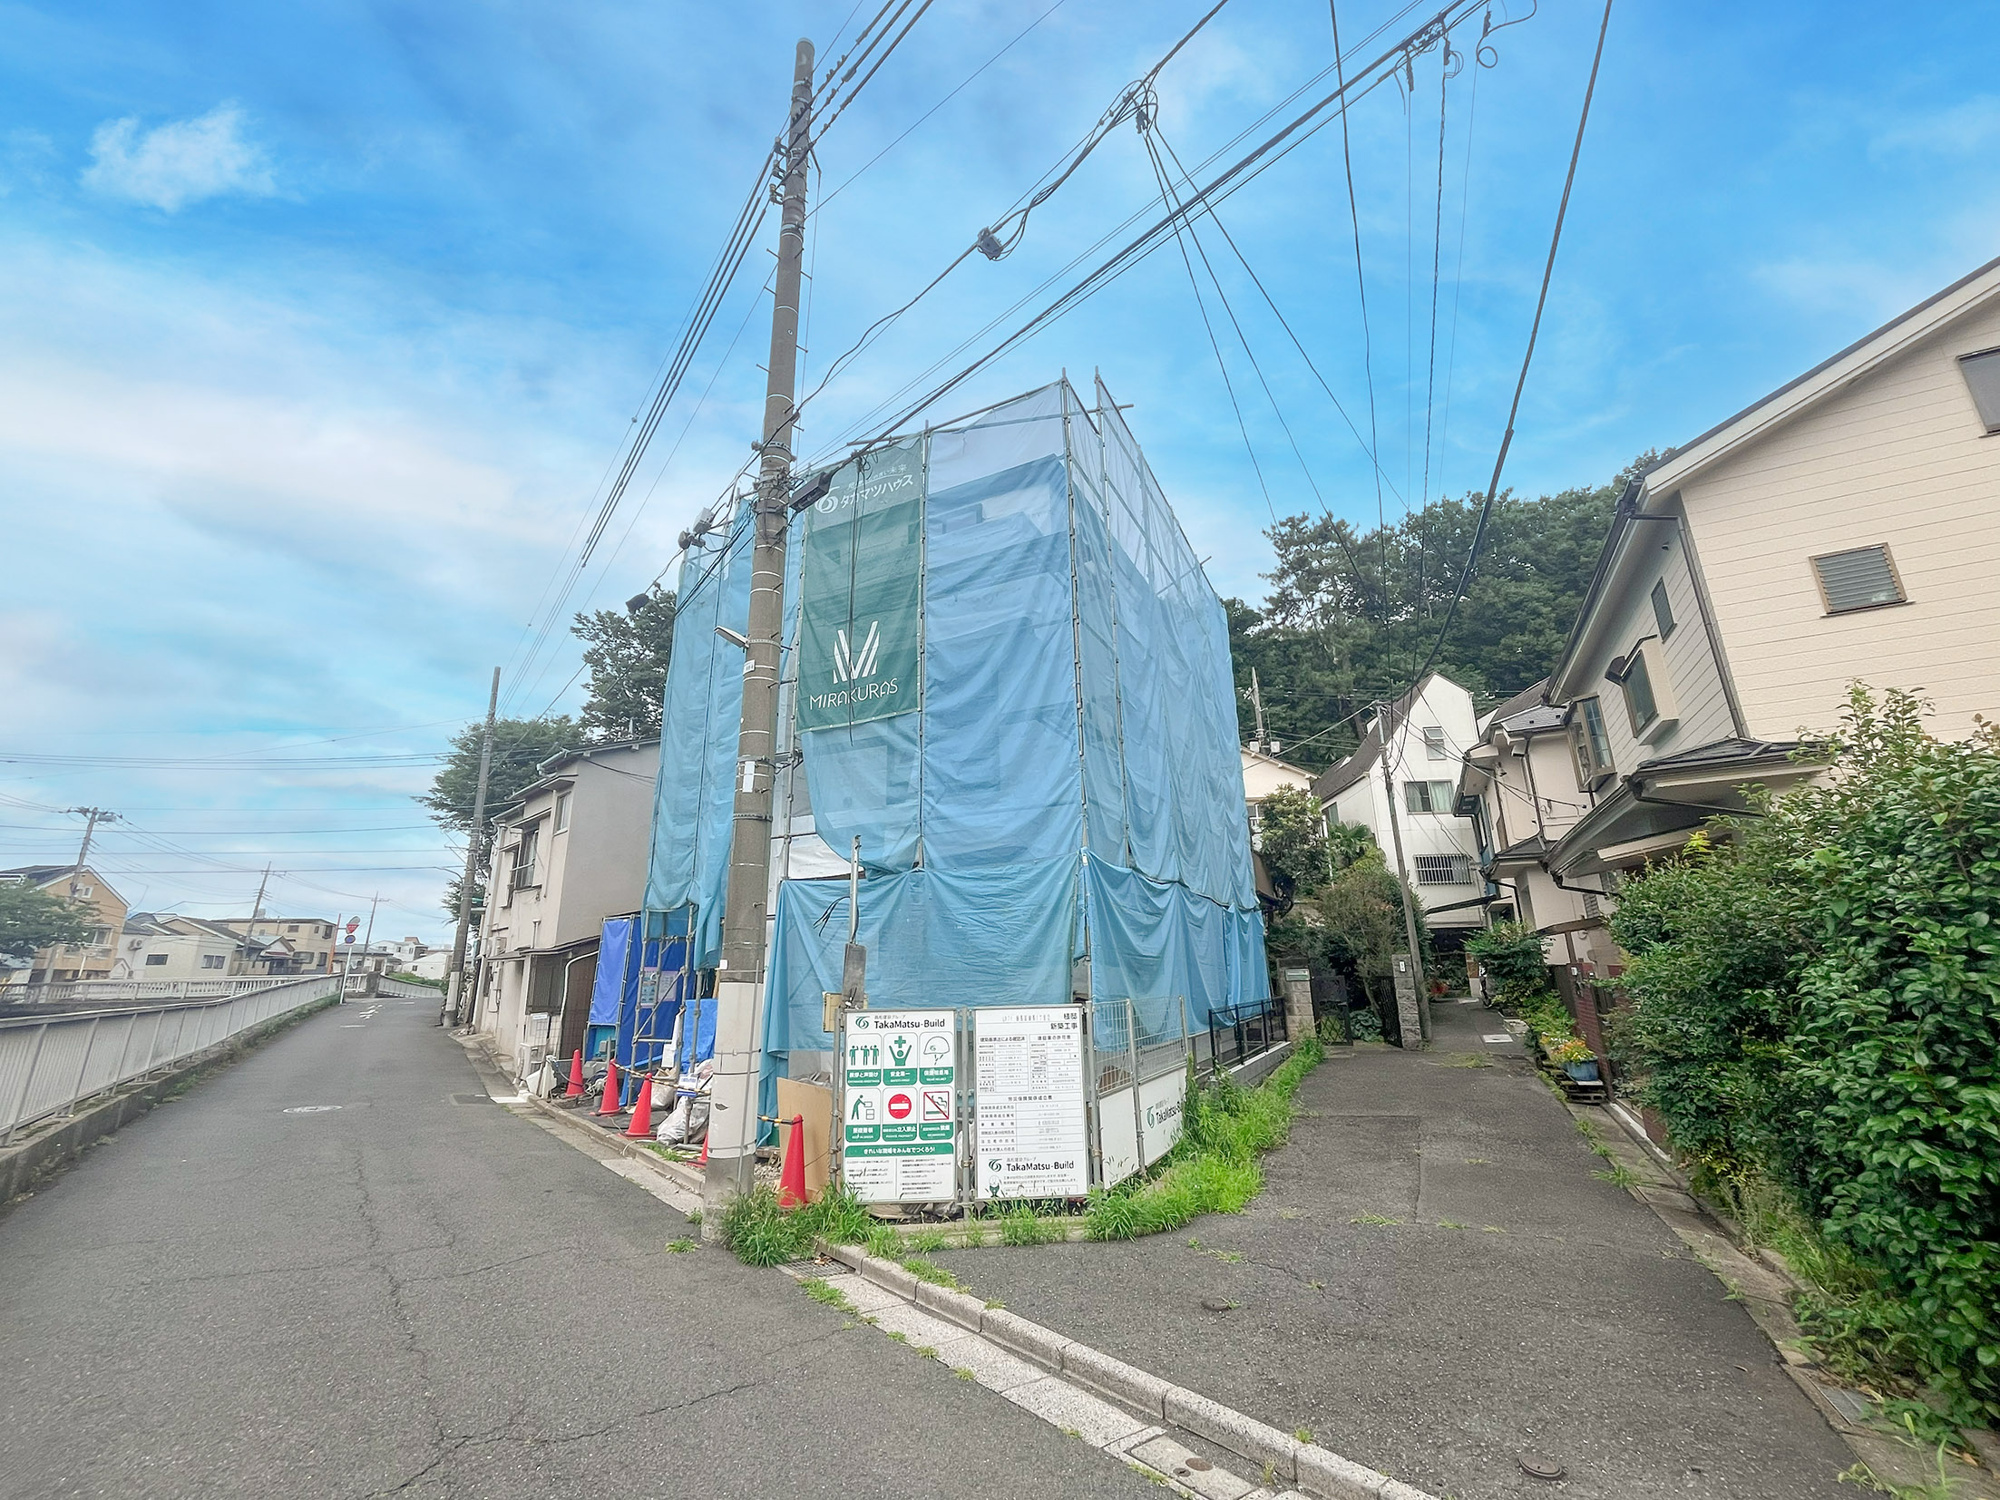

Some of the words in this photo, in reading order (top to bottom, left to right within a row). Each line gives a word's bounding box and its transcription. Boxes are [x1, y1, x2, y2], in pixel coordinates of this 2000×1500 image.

[840, 474, 914, 509] タカマツハウス
[809, 677, 898, 711] MIRAKURAS
[874, 1018, 946, 1029] TakaMatsu-Build
[1050, 1022, 1078, 1030] 新築工事
[1006, 1160, 1075, 1172] TakaMatsu-Build
